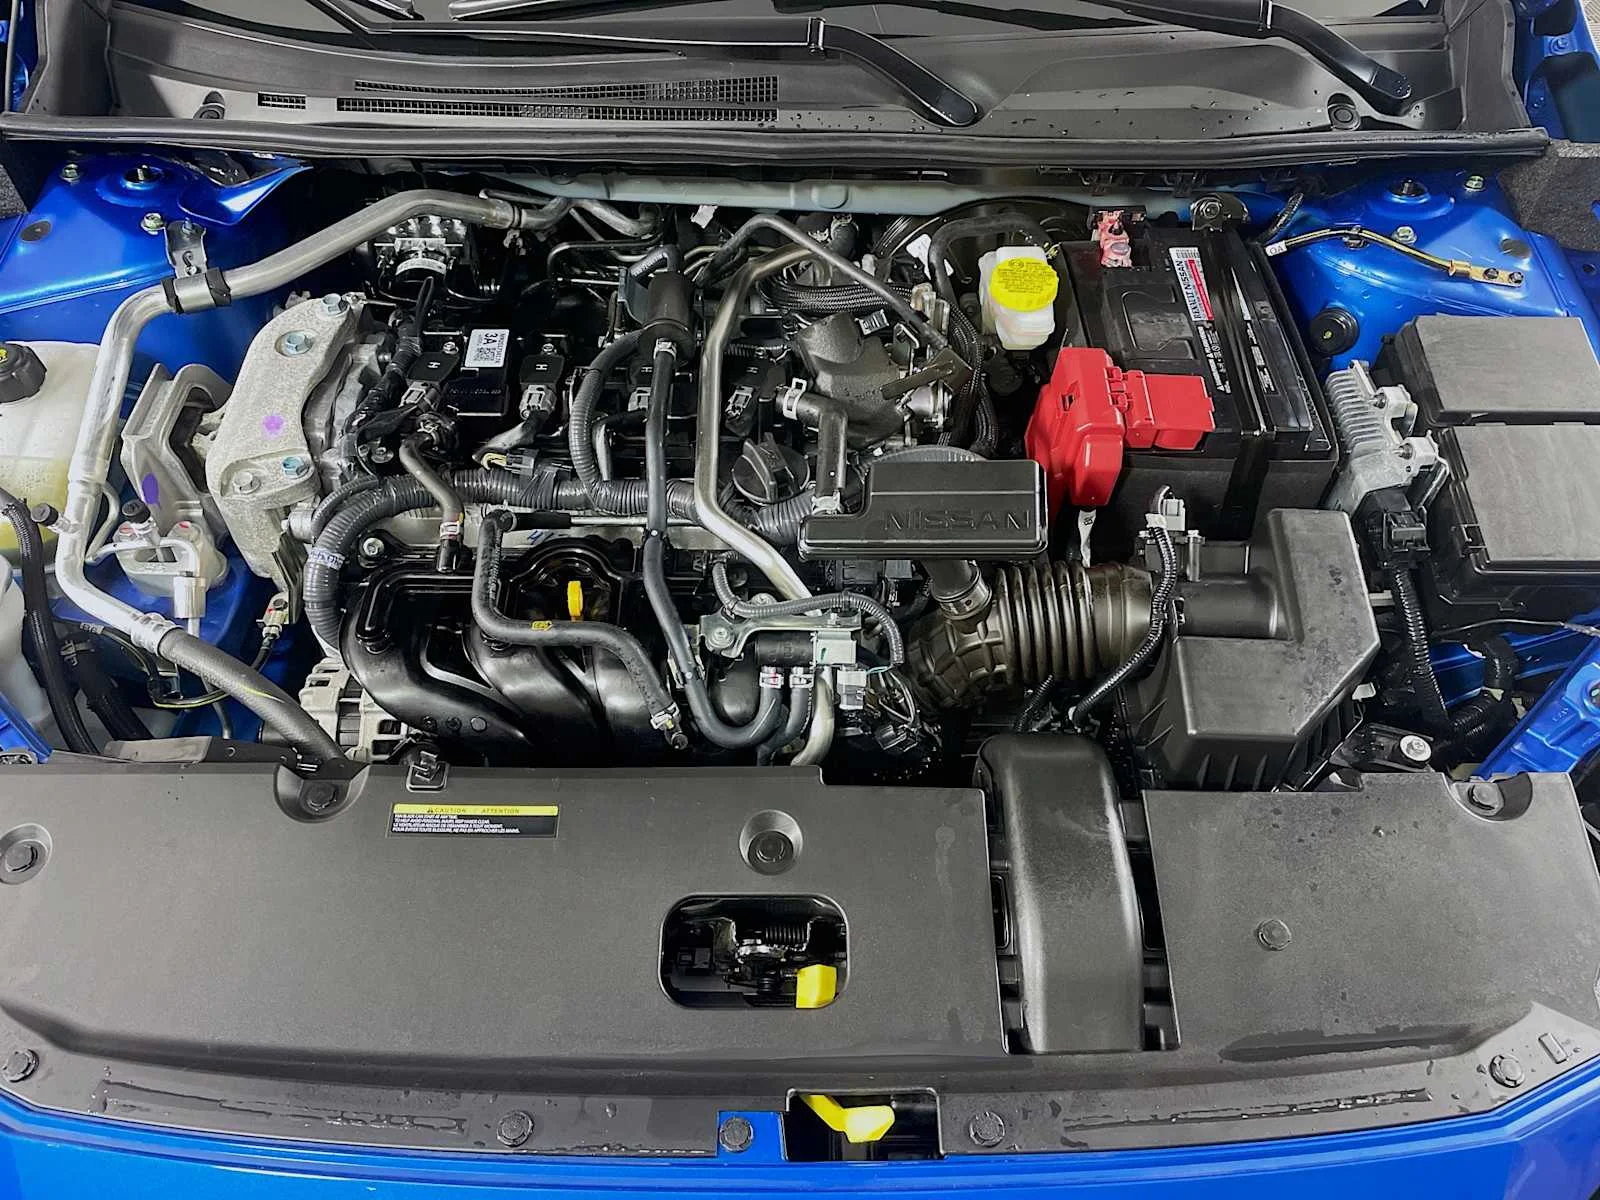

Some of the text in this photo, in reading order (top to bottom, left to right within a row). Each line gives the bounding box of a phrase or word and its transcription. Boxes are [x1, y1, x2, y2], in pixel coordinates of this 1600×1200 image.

[1177, 260, 1191, 290] NISSAN
[483, 332, 498, 345] 3A
[884, 508, 1031, 531] NISSAN
